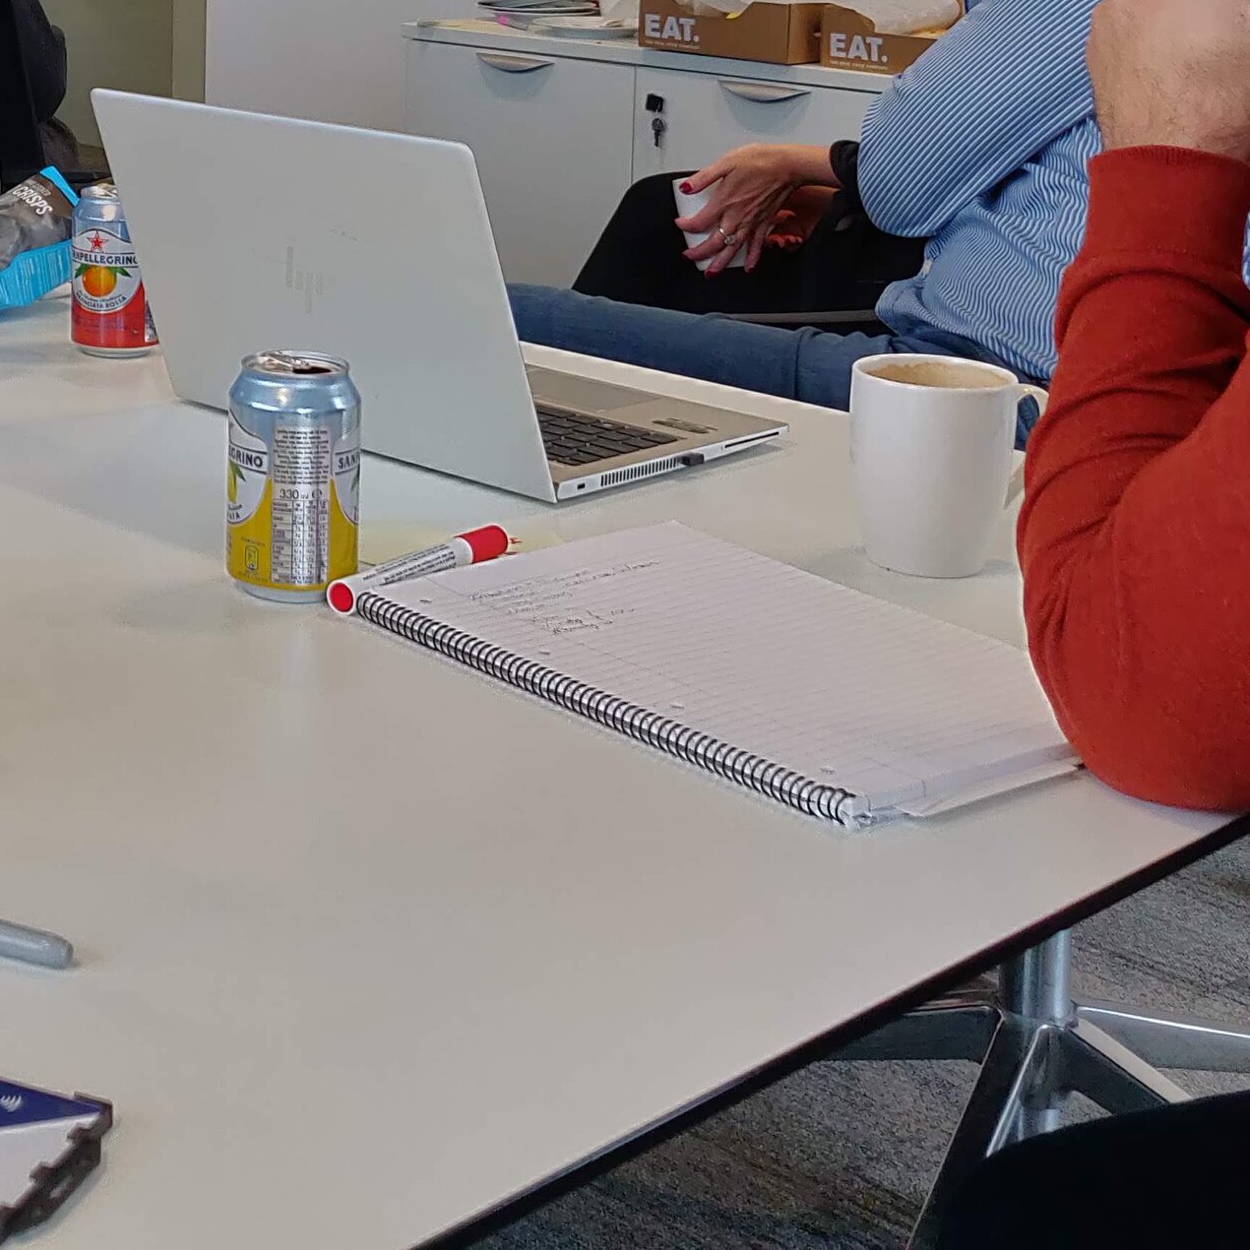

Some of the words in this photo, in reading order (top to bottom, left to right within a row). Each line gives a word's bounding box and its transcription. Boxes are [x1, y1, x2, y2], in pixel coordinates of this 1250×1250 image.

[645, 14, 700, 43] EAT.
[830, 33, 888, 63] EAT.
[12, 186, 53, 215] CRISPS
[279, 488, 300, 500] 330
